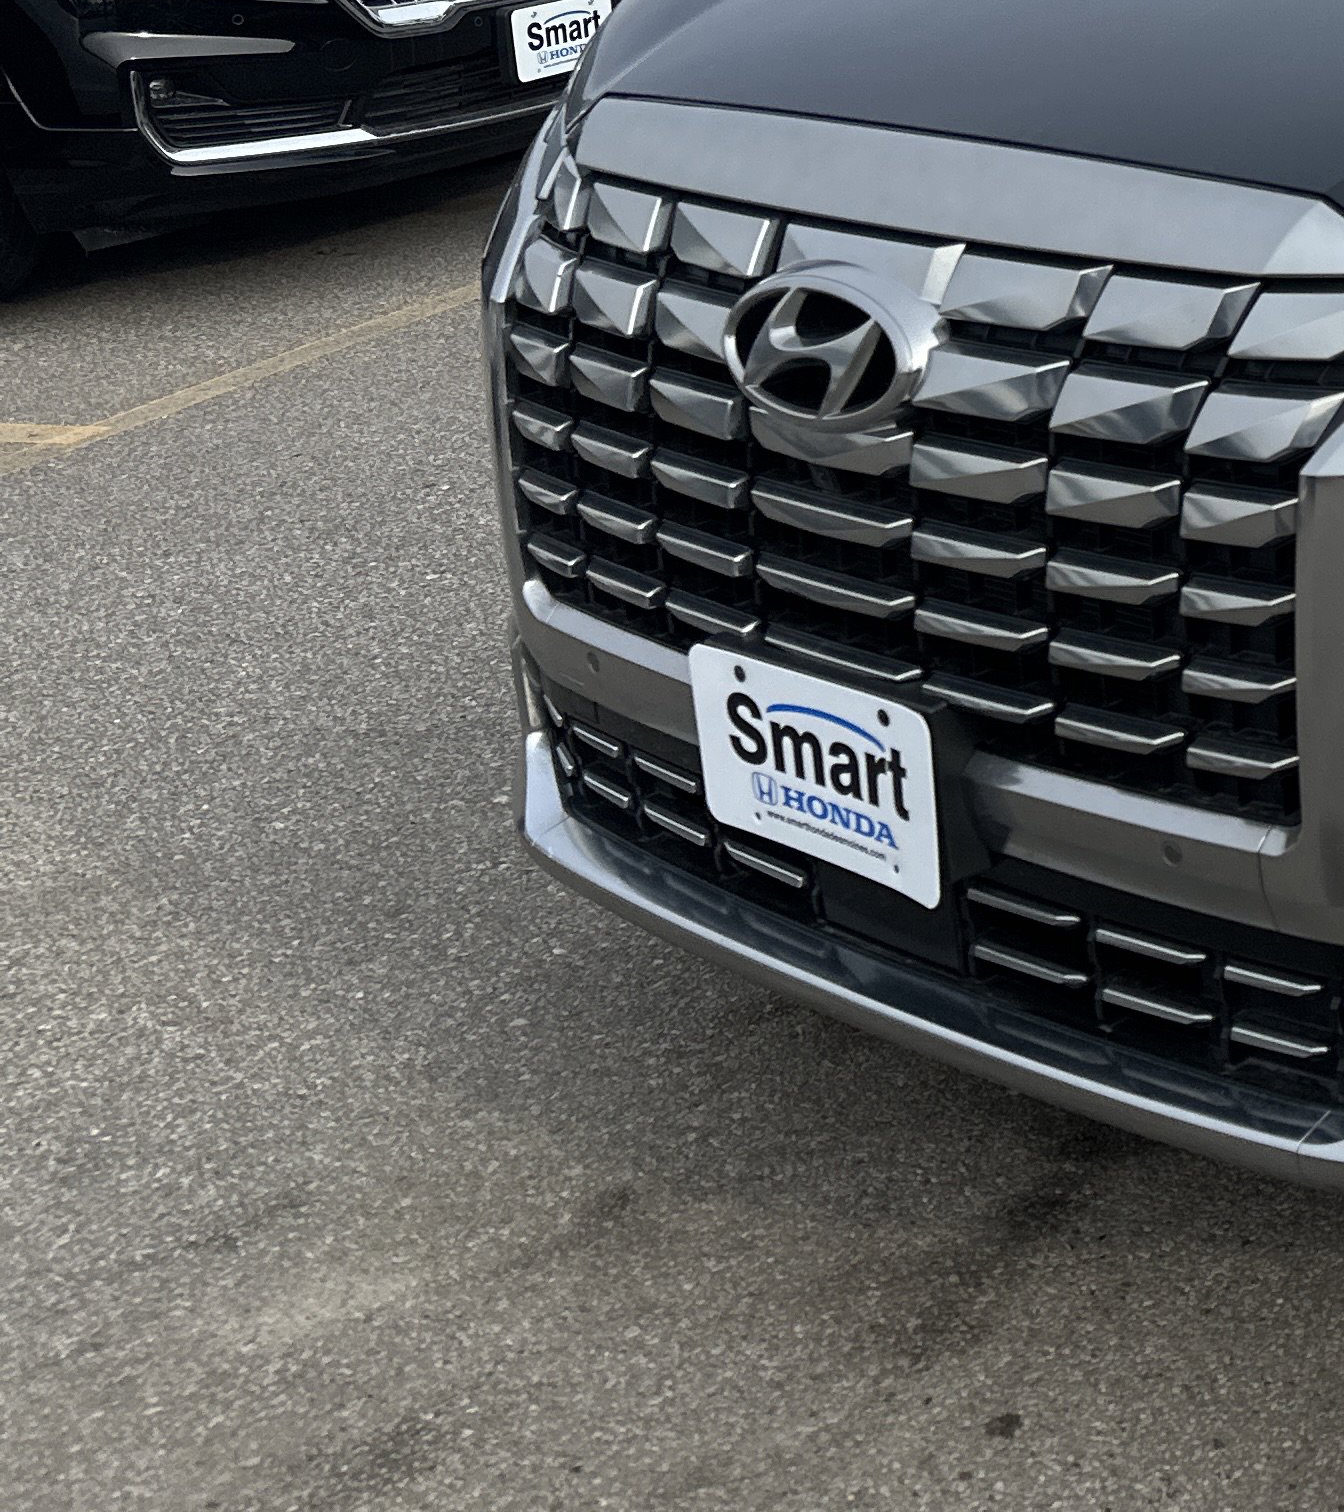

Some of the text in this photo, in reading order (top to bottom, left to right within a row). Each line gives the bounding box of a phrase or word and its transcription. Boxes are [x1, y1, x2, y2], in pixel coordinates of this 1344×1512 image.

[527, 9, 601, 51] Smart
[727, 692, 911, 821] Smart
[780, 785, 900, 850] HONDA
